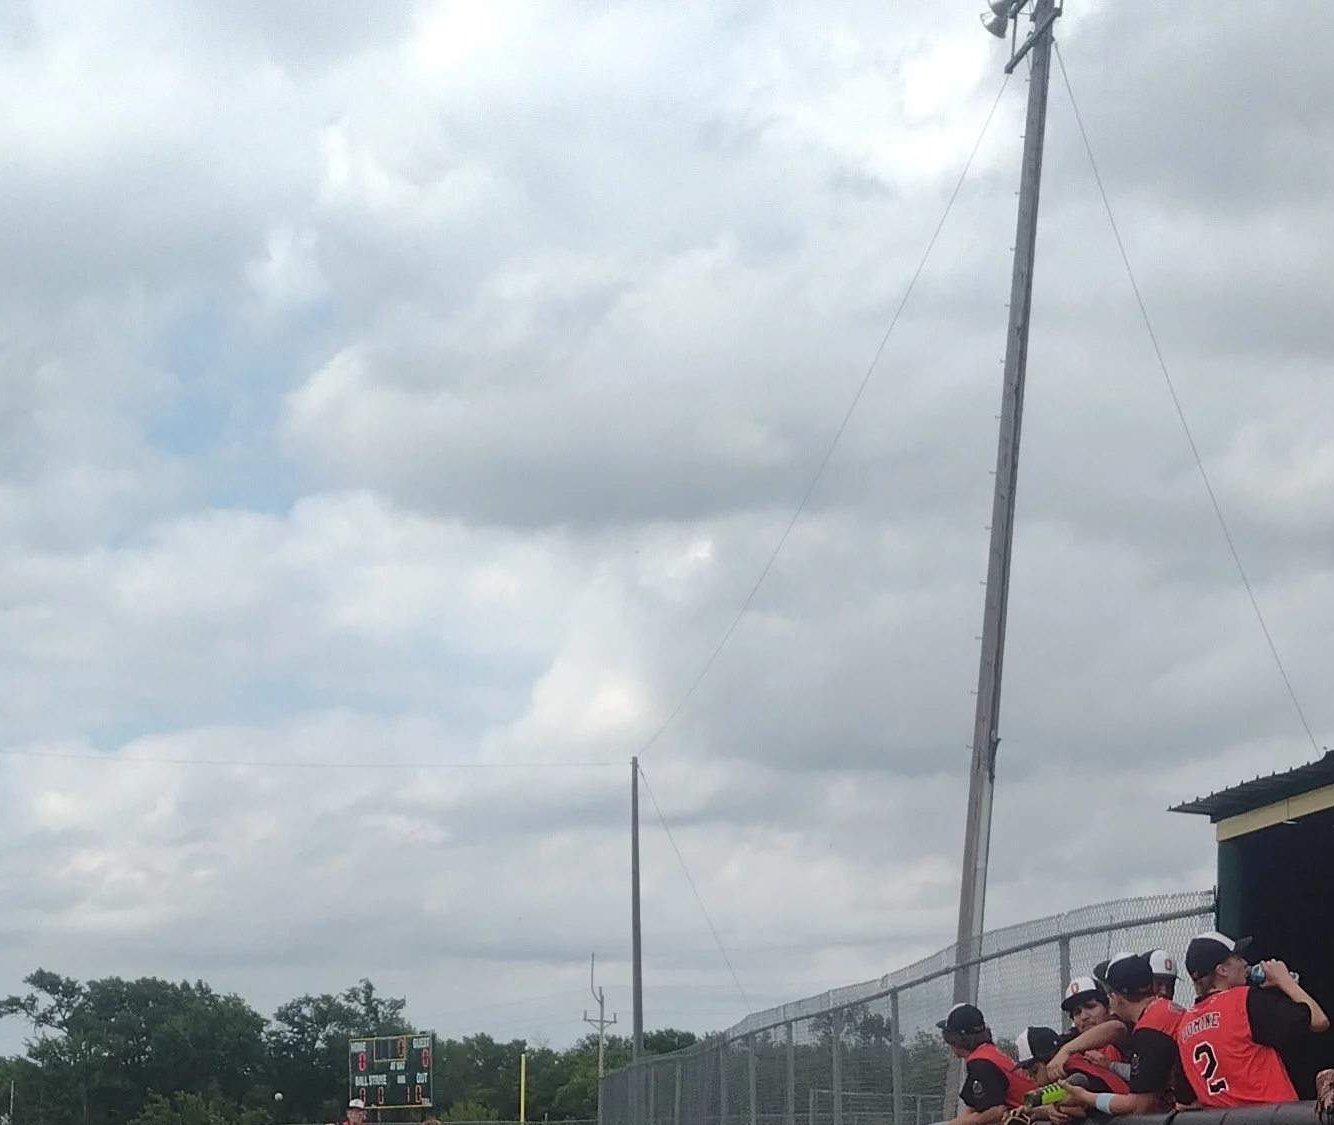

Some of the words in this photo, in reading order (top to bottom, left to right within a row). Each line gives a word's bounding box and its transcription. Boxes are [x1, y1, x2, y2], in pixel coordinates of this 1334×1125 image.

[412, 1037, 430, 1049] GUEST
[1193, 1041, 1229, 1096] 2
[355, 1075, 368, 1086] BALL
[368, 1074, 387, 1086] STRIKE
[416, 1072, 428, 1083] OUT
